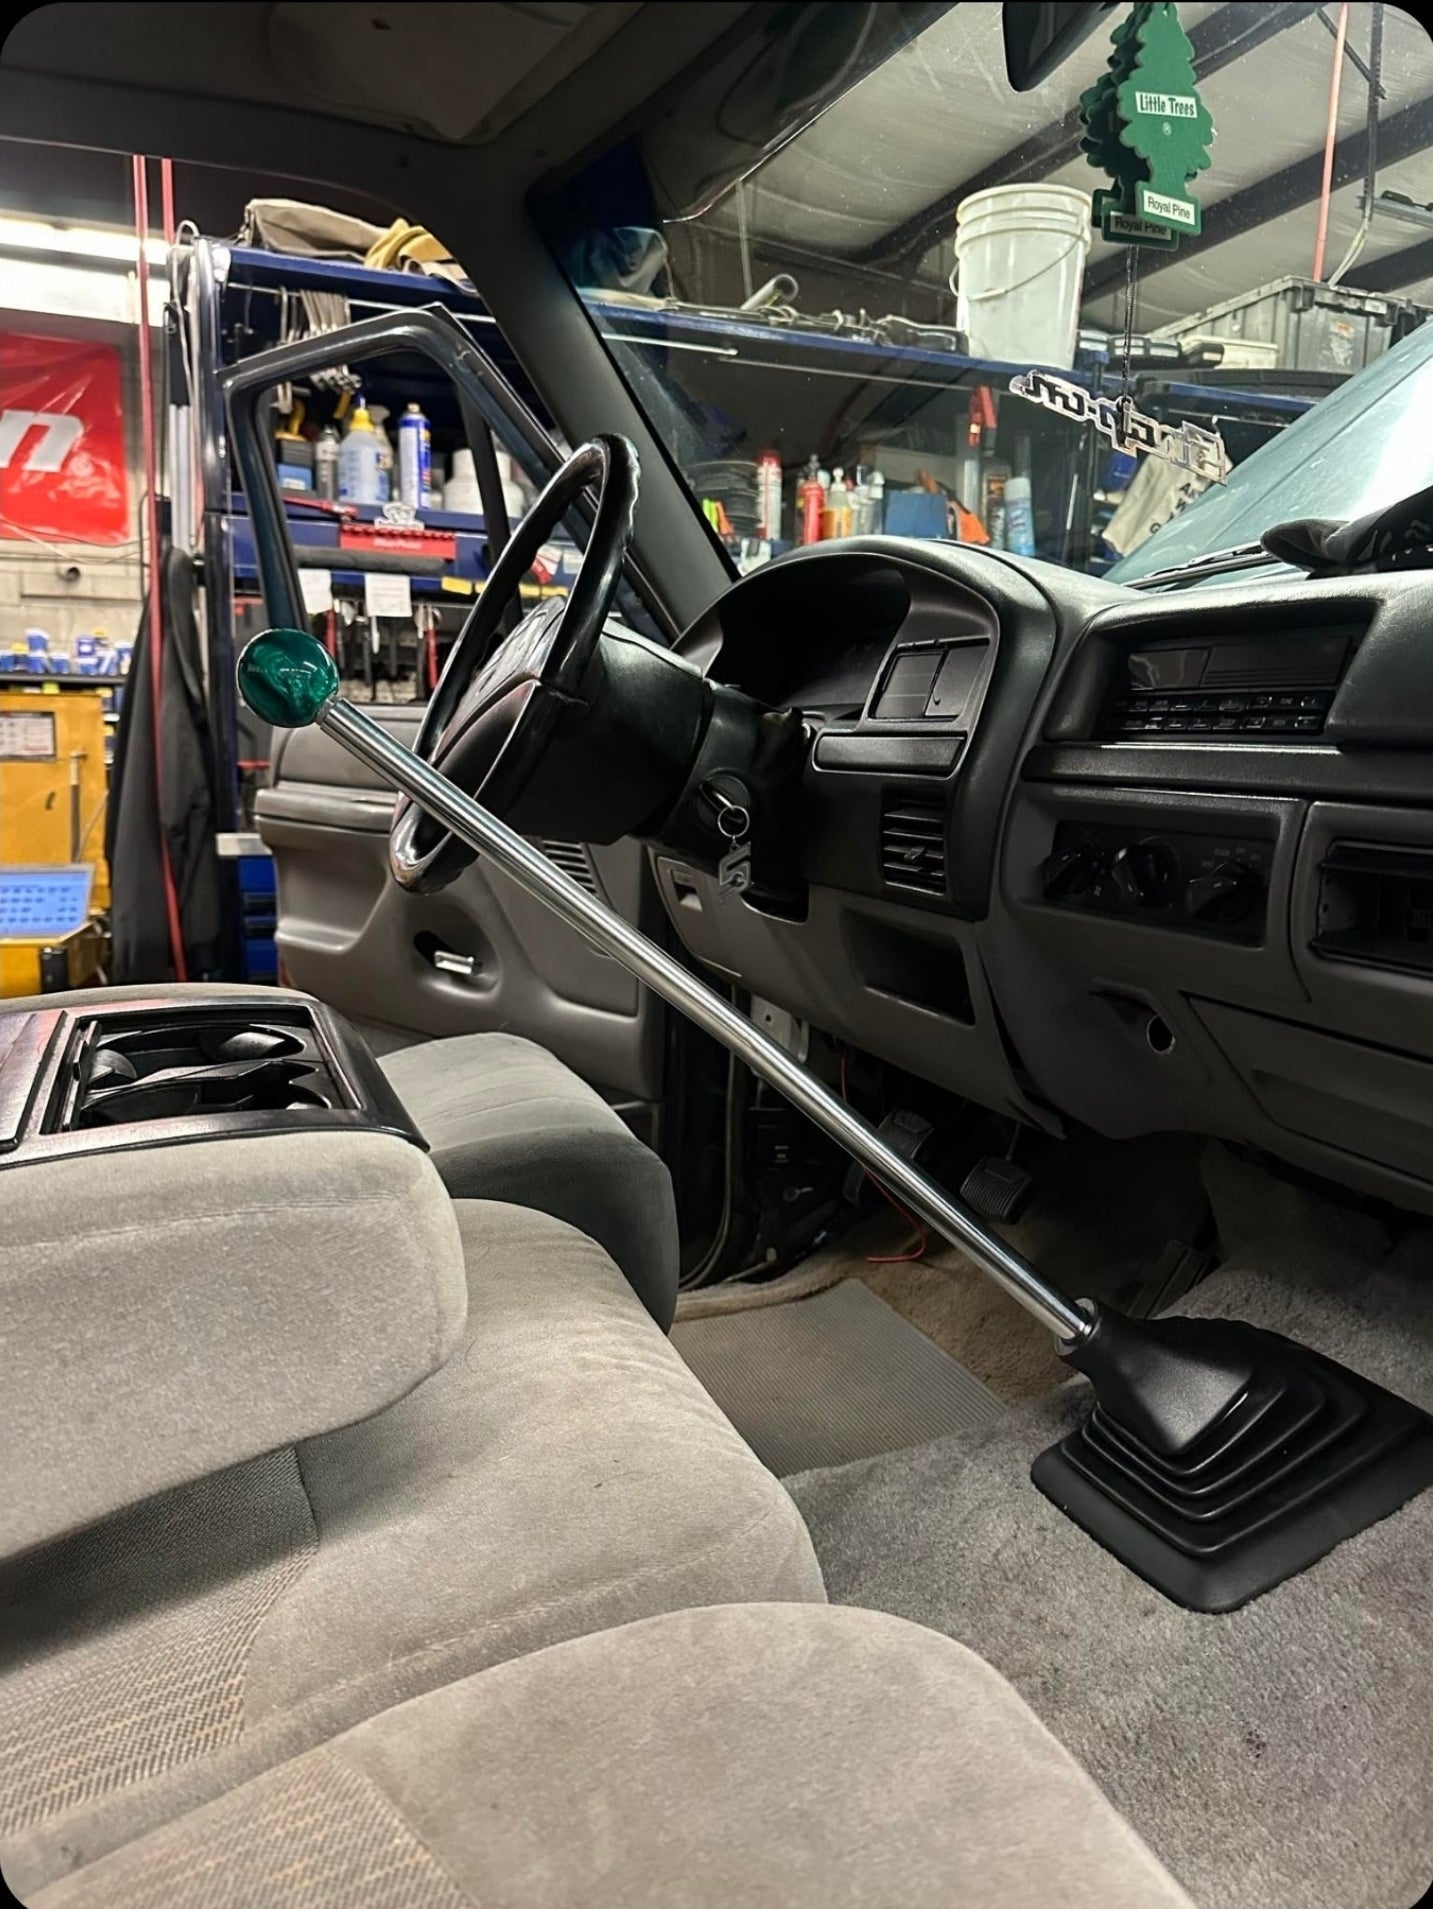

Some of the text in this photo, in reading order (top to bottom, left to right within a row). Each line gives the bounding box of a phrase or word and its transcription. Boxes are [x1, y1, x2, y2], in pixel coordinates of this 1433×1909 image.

[1139, 93, 1195, 116] Little Trees
[1147, 195, 1191, 219] Royal Pine
[1115, 215, 1167, 236] Royal Pine
